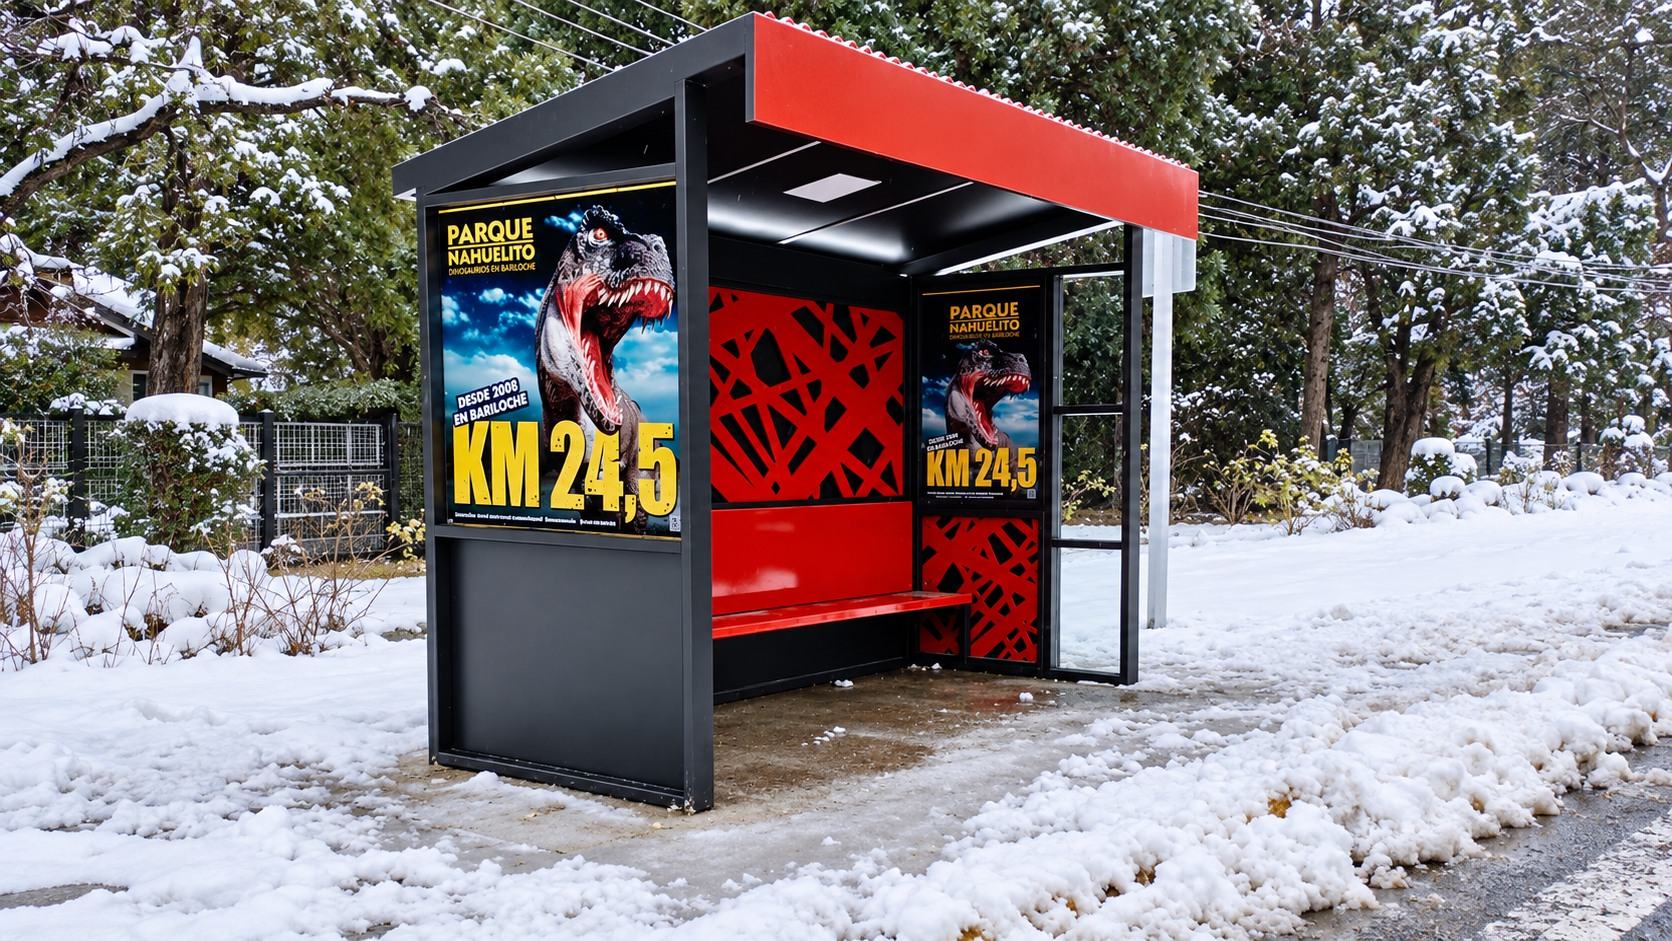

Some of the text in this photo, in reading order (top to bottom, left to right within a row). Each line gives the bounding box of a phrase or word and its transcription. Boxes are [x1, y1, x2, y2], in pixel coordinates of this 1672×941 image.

[447, 217, 534, 245] PARQUE
[448, 243, 536, 266] NAHUELITO
[949, 302, 1019, 320] PARQUE
[949, 319, 1020, 334] NAHUELITO
[457, 379, 518, 409] DESDE 2008
[453, 392, 528, 426] EN BARILOCHE
[452, 420, 677, 524] KM 24,5
[927, 447, 1037, 492] KM 24,5
